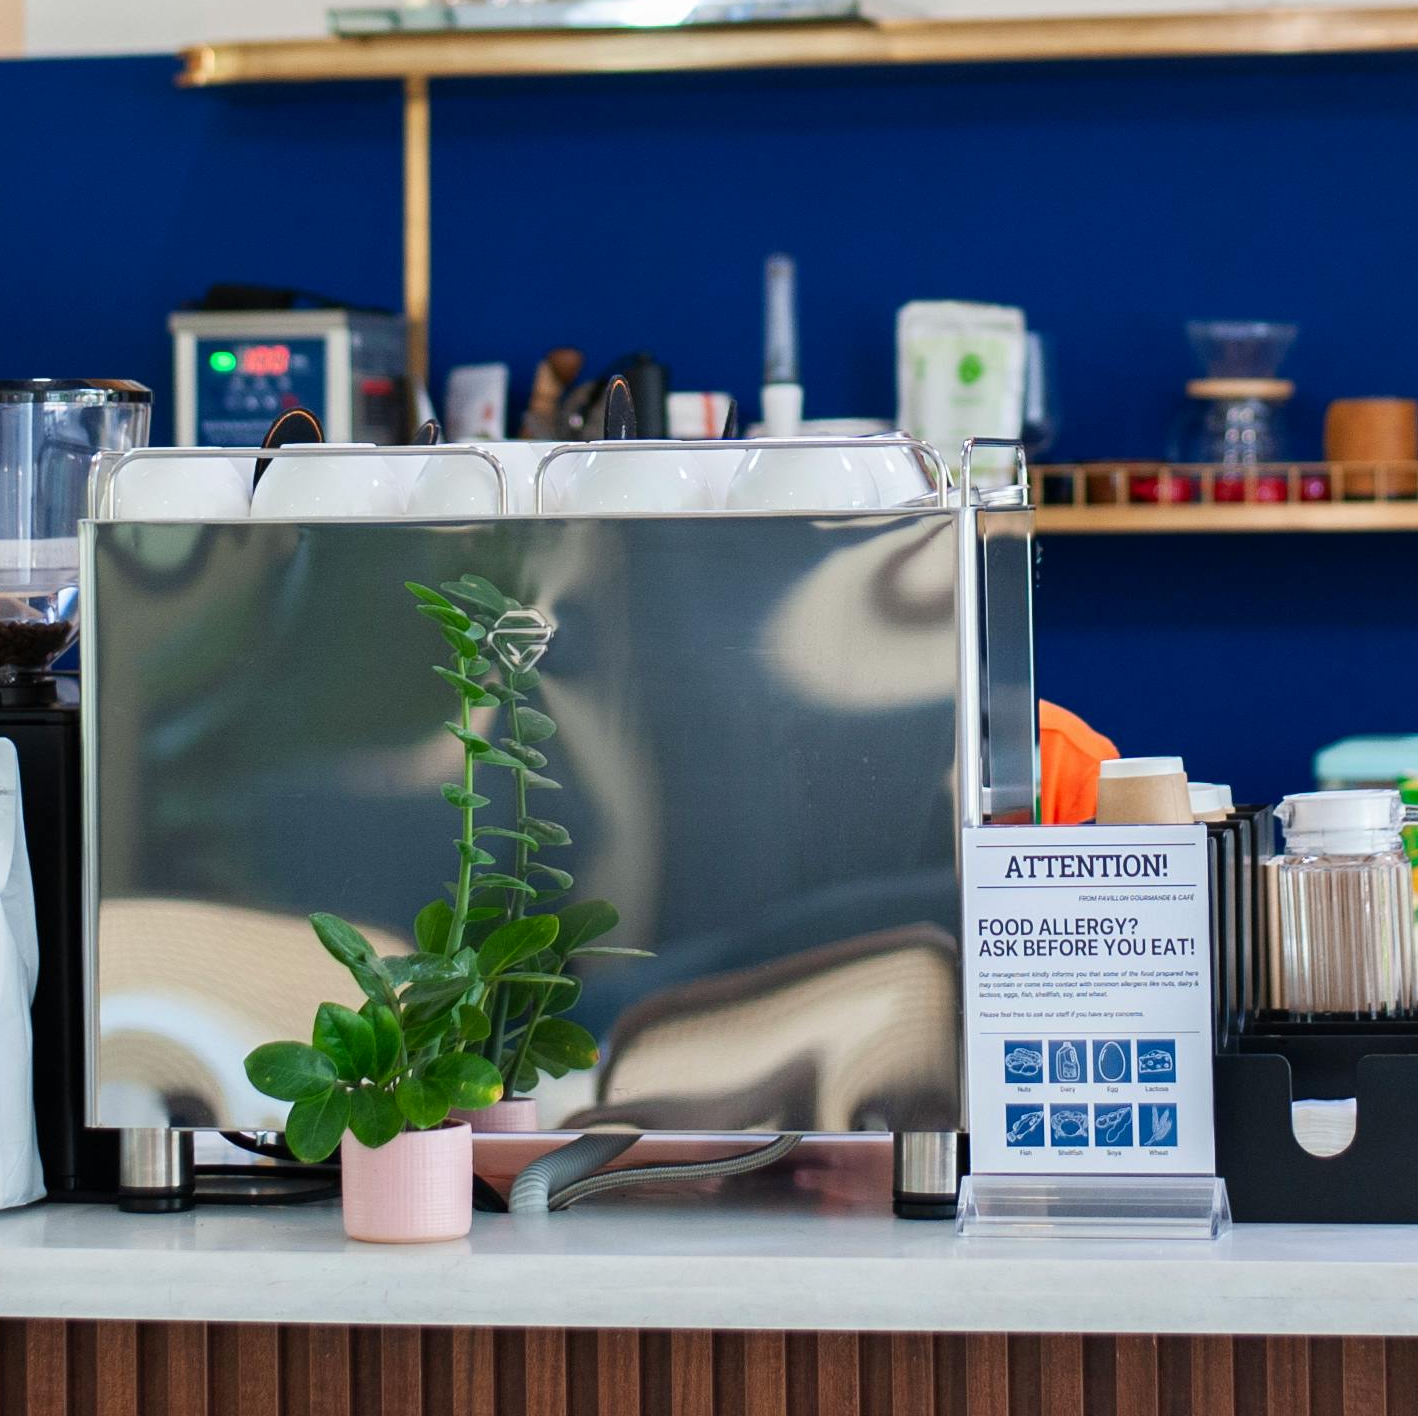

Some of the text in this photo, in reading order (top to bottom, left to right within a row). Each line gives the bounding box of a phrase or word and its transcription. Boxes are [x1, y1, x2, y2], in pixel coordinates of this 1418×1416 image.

[1004, 854, 1169, 879] ATTENTION!
[978, 918, 1139, 936] FOOD ALLERGY?
[979, 938, 1195, 957] ASK BEFORE YOU EAT!
[1156, 970, 1184, 978] prepared
[1106, 1086, 1119, 1094] Egg
[1145, 1085, 1169, 1093] Lactose
